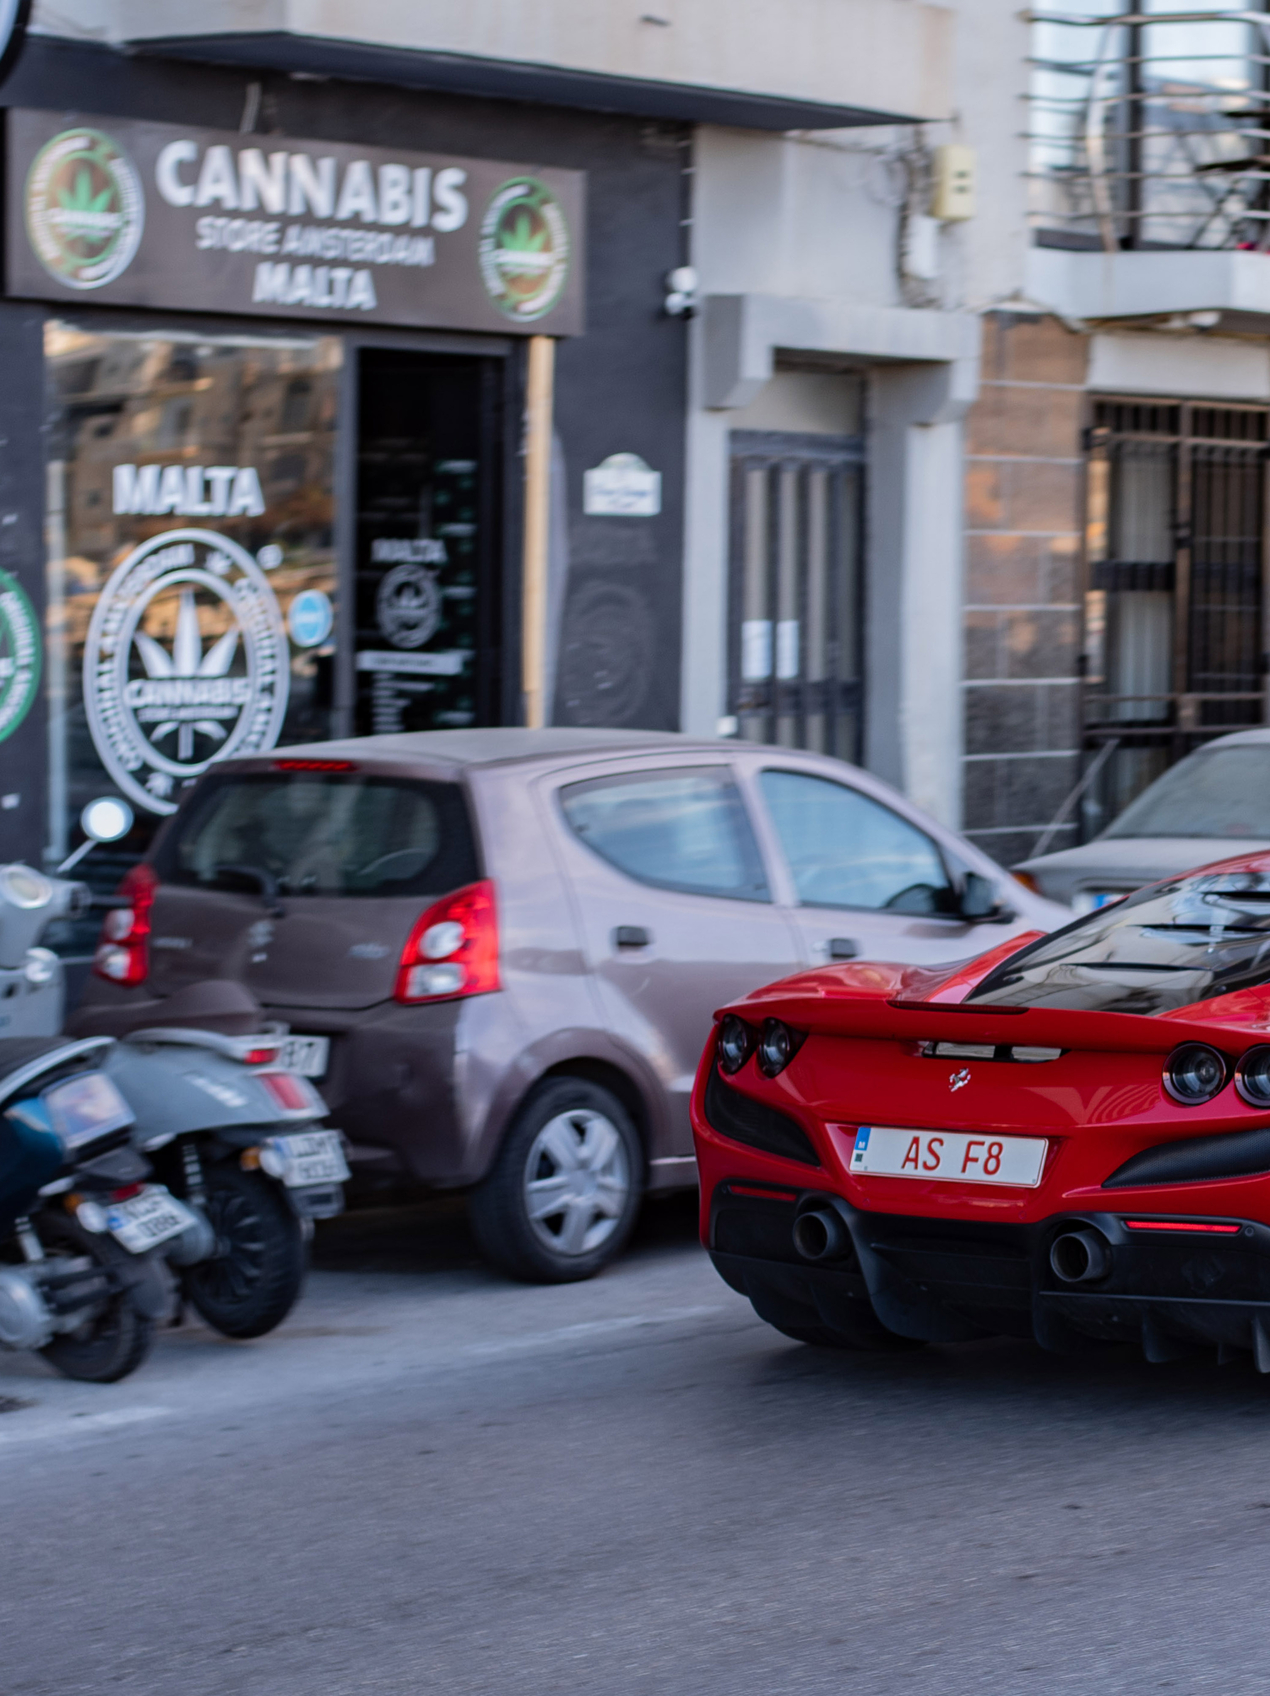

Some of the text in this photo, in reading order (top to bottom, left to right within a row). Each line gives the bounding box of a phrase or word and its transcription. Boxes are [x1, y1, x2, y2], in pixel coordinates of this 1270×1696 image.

[155, 139, 470, 233] CANNABIS
[195, 215, 436, 268] STORE AMSTERDAM
[252, 260, 378, 312] MALTA
[112, 463, 266, 518] MALTA
[371, 537, 447, 563] MALTA
[901, 1136, 1004, 1176] AS F8
